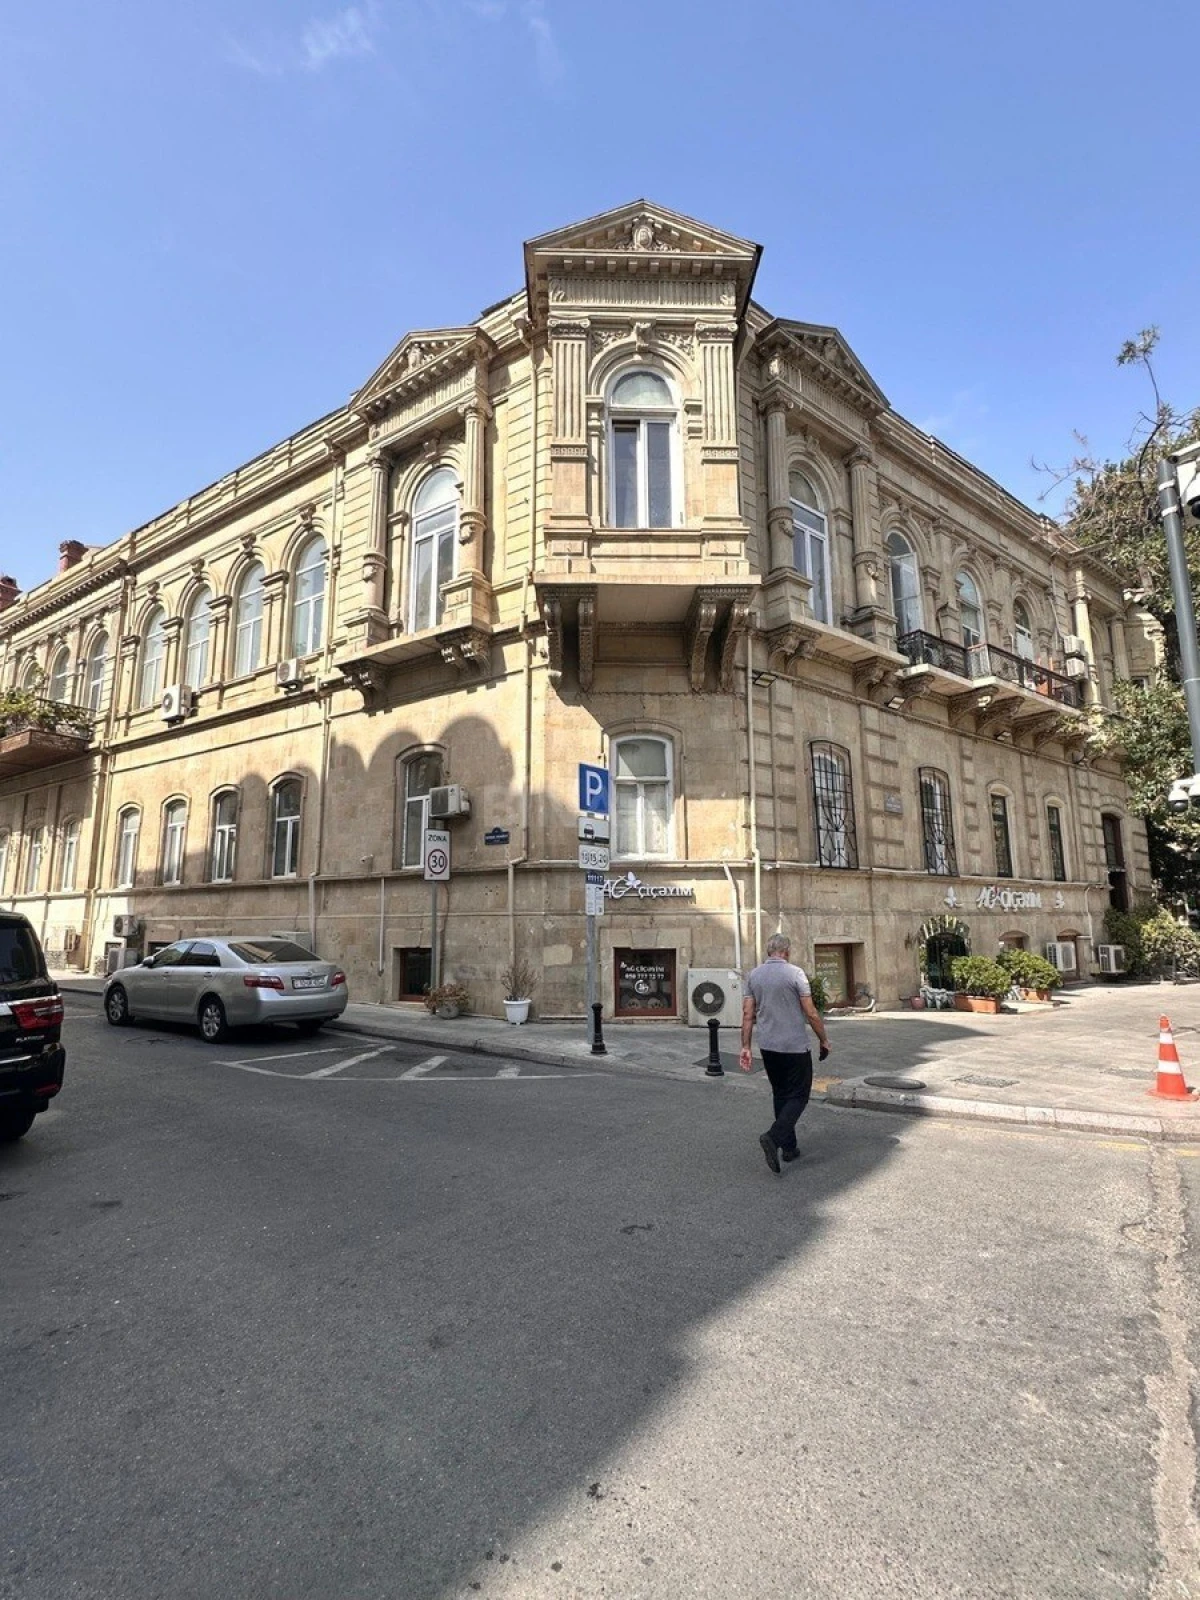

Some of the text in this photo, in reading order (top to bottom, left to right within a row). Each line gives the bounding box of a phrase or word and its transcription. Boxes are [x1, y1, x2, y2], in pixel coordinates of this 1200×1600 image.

[586, 770, 603, 807] P
[428, 834, 447, 842] ZONA
[431, 855, 445, 868] 30
